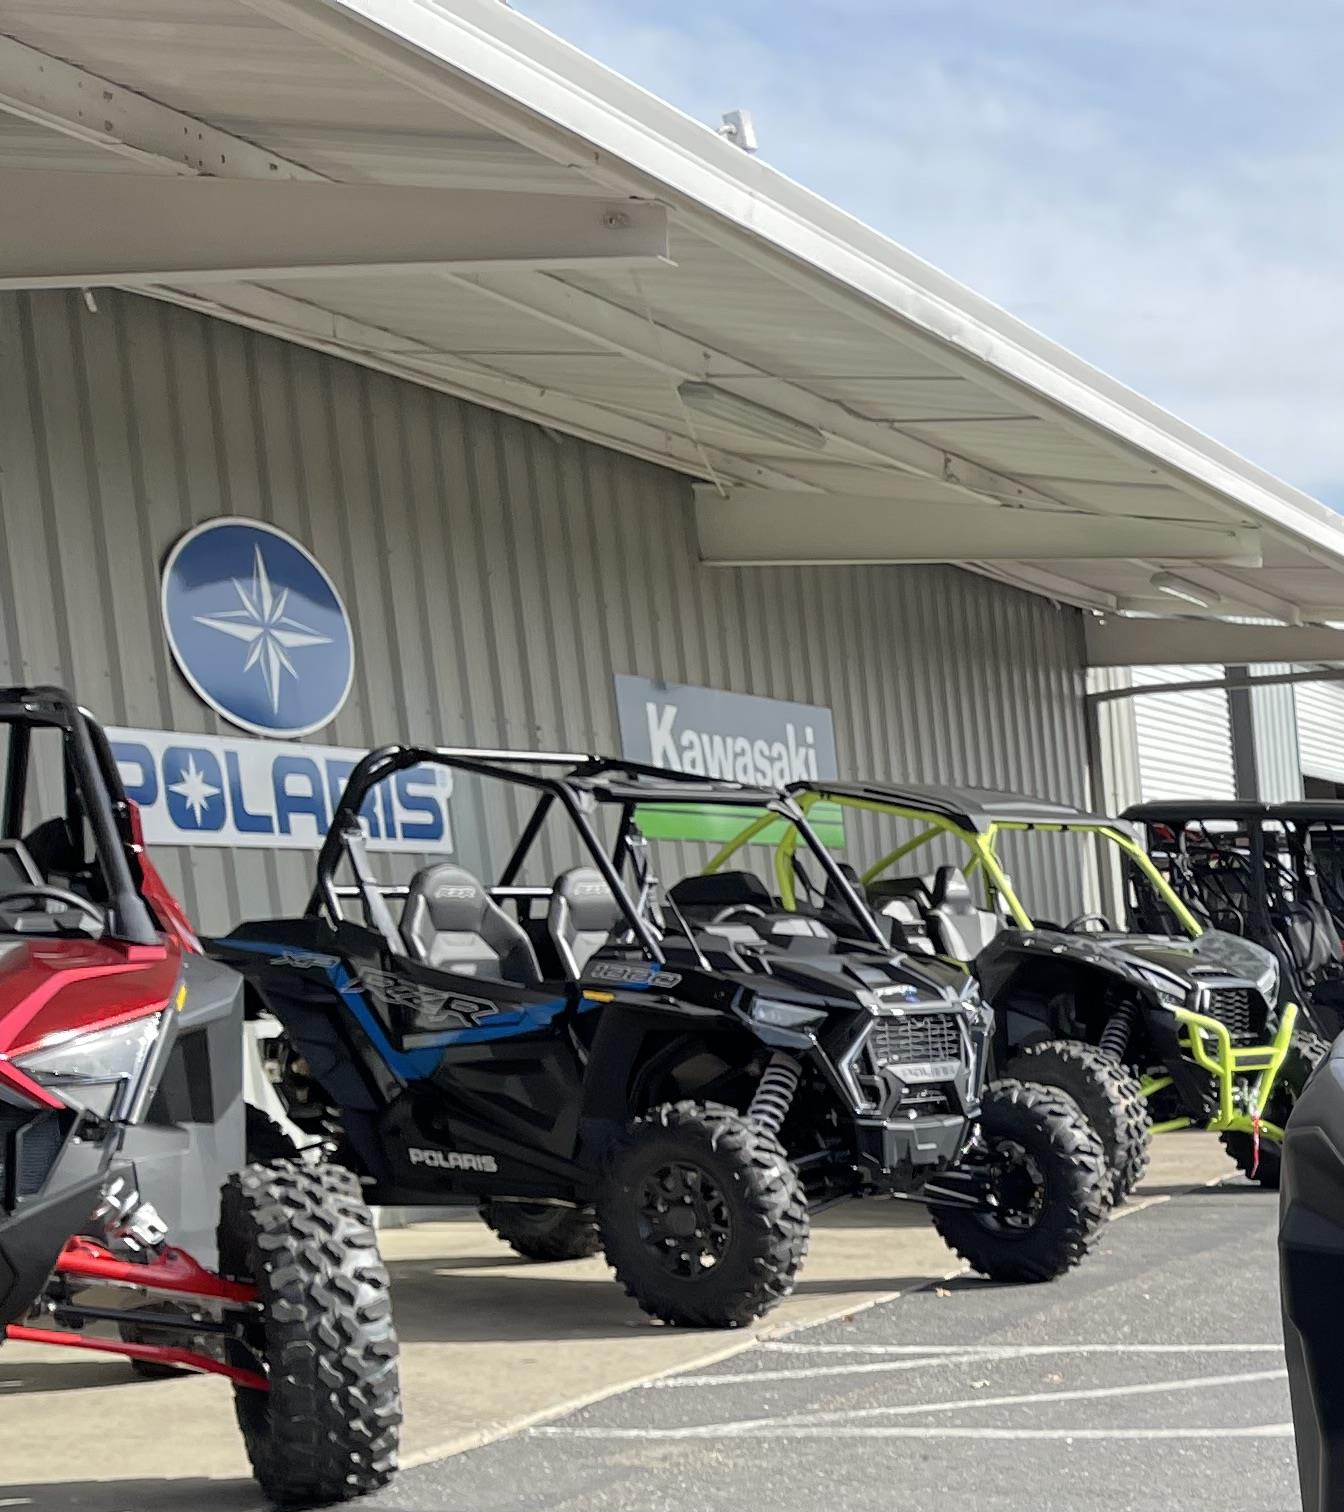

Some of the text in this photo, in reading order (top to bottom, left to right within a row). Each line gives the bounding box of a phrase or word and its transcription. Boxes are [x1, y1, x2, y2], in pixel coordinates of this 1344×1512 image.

[646, 702, 819, 789] Kawasaki
[110, 742, 445, 842] POLARIS
[408, 1147, 498, 1173] POLARIS
